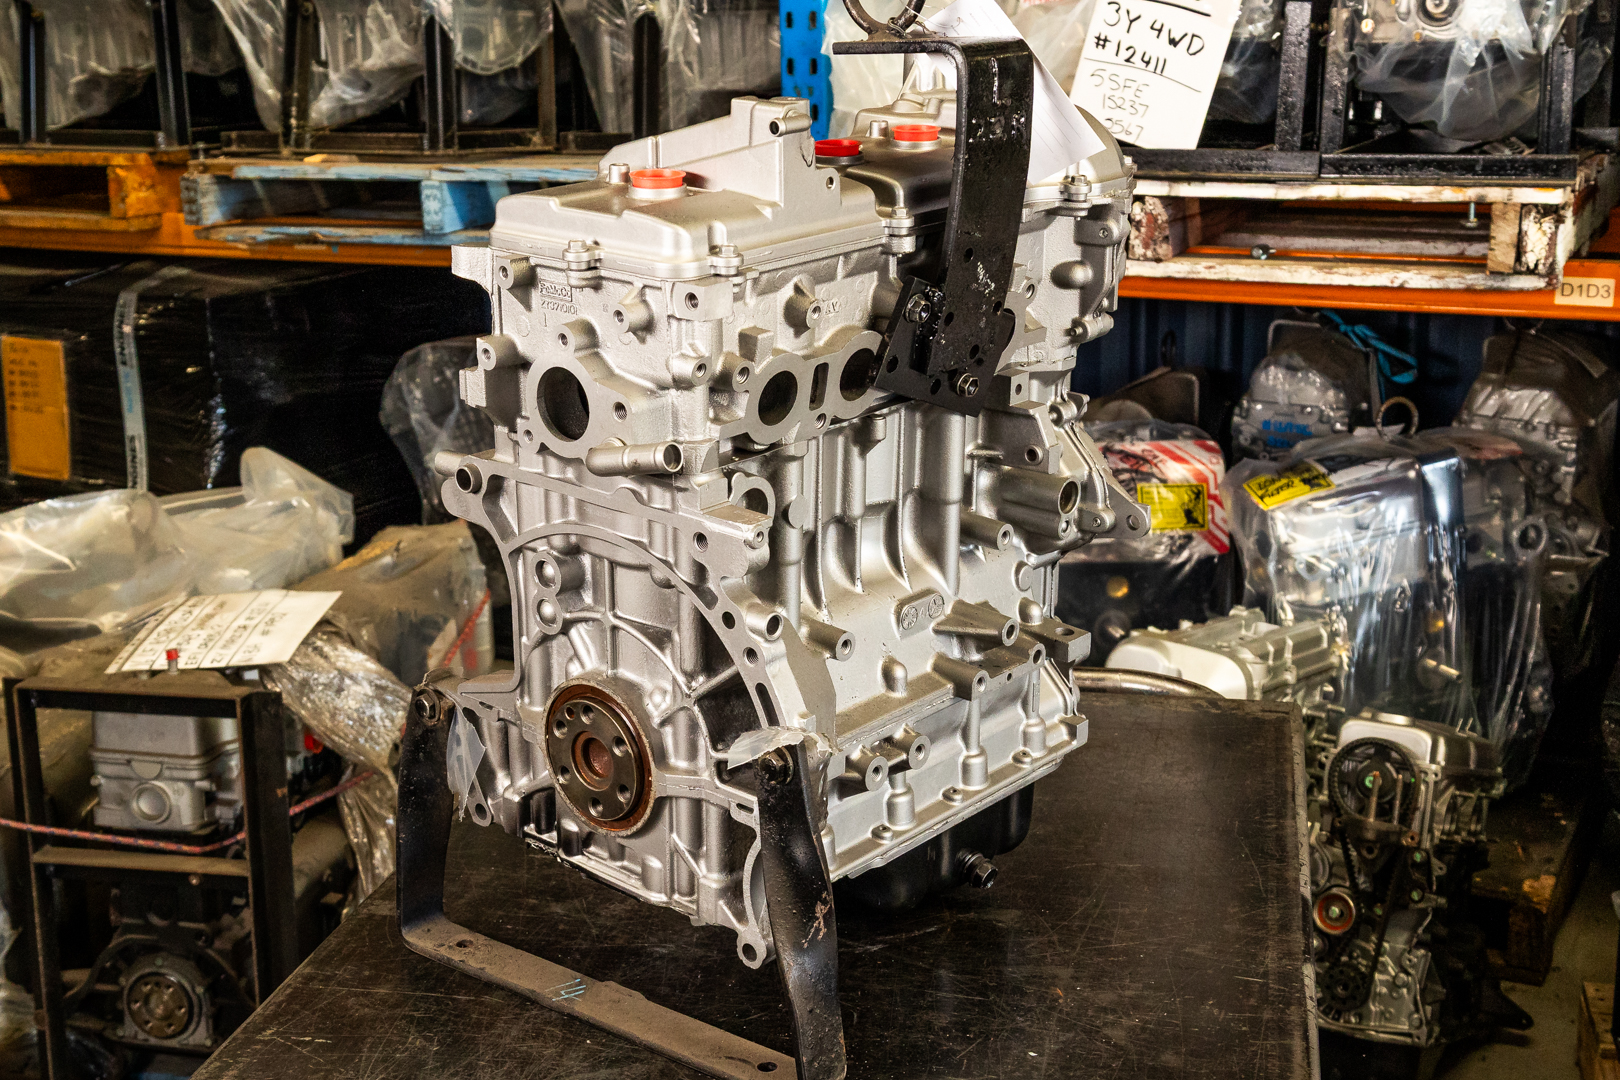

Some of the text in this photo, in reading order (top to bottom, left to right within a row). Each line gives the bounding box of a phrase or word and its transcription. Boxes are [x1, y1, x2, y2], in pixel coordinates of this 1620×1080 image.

[1103, 1, 1205, 56] 3Y 4WD
[1094, 32, 1168, 75] #12411
[1561, 282, 1611, 299] D1D3
